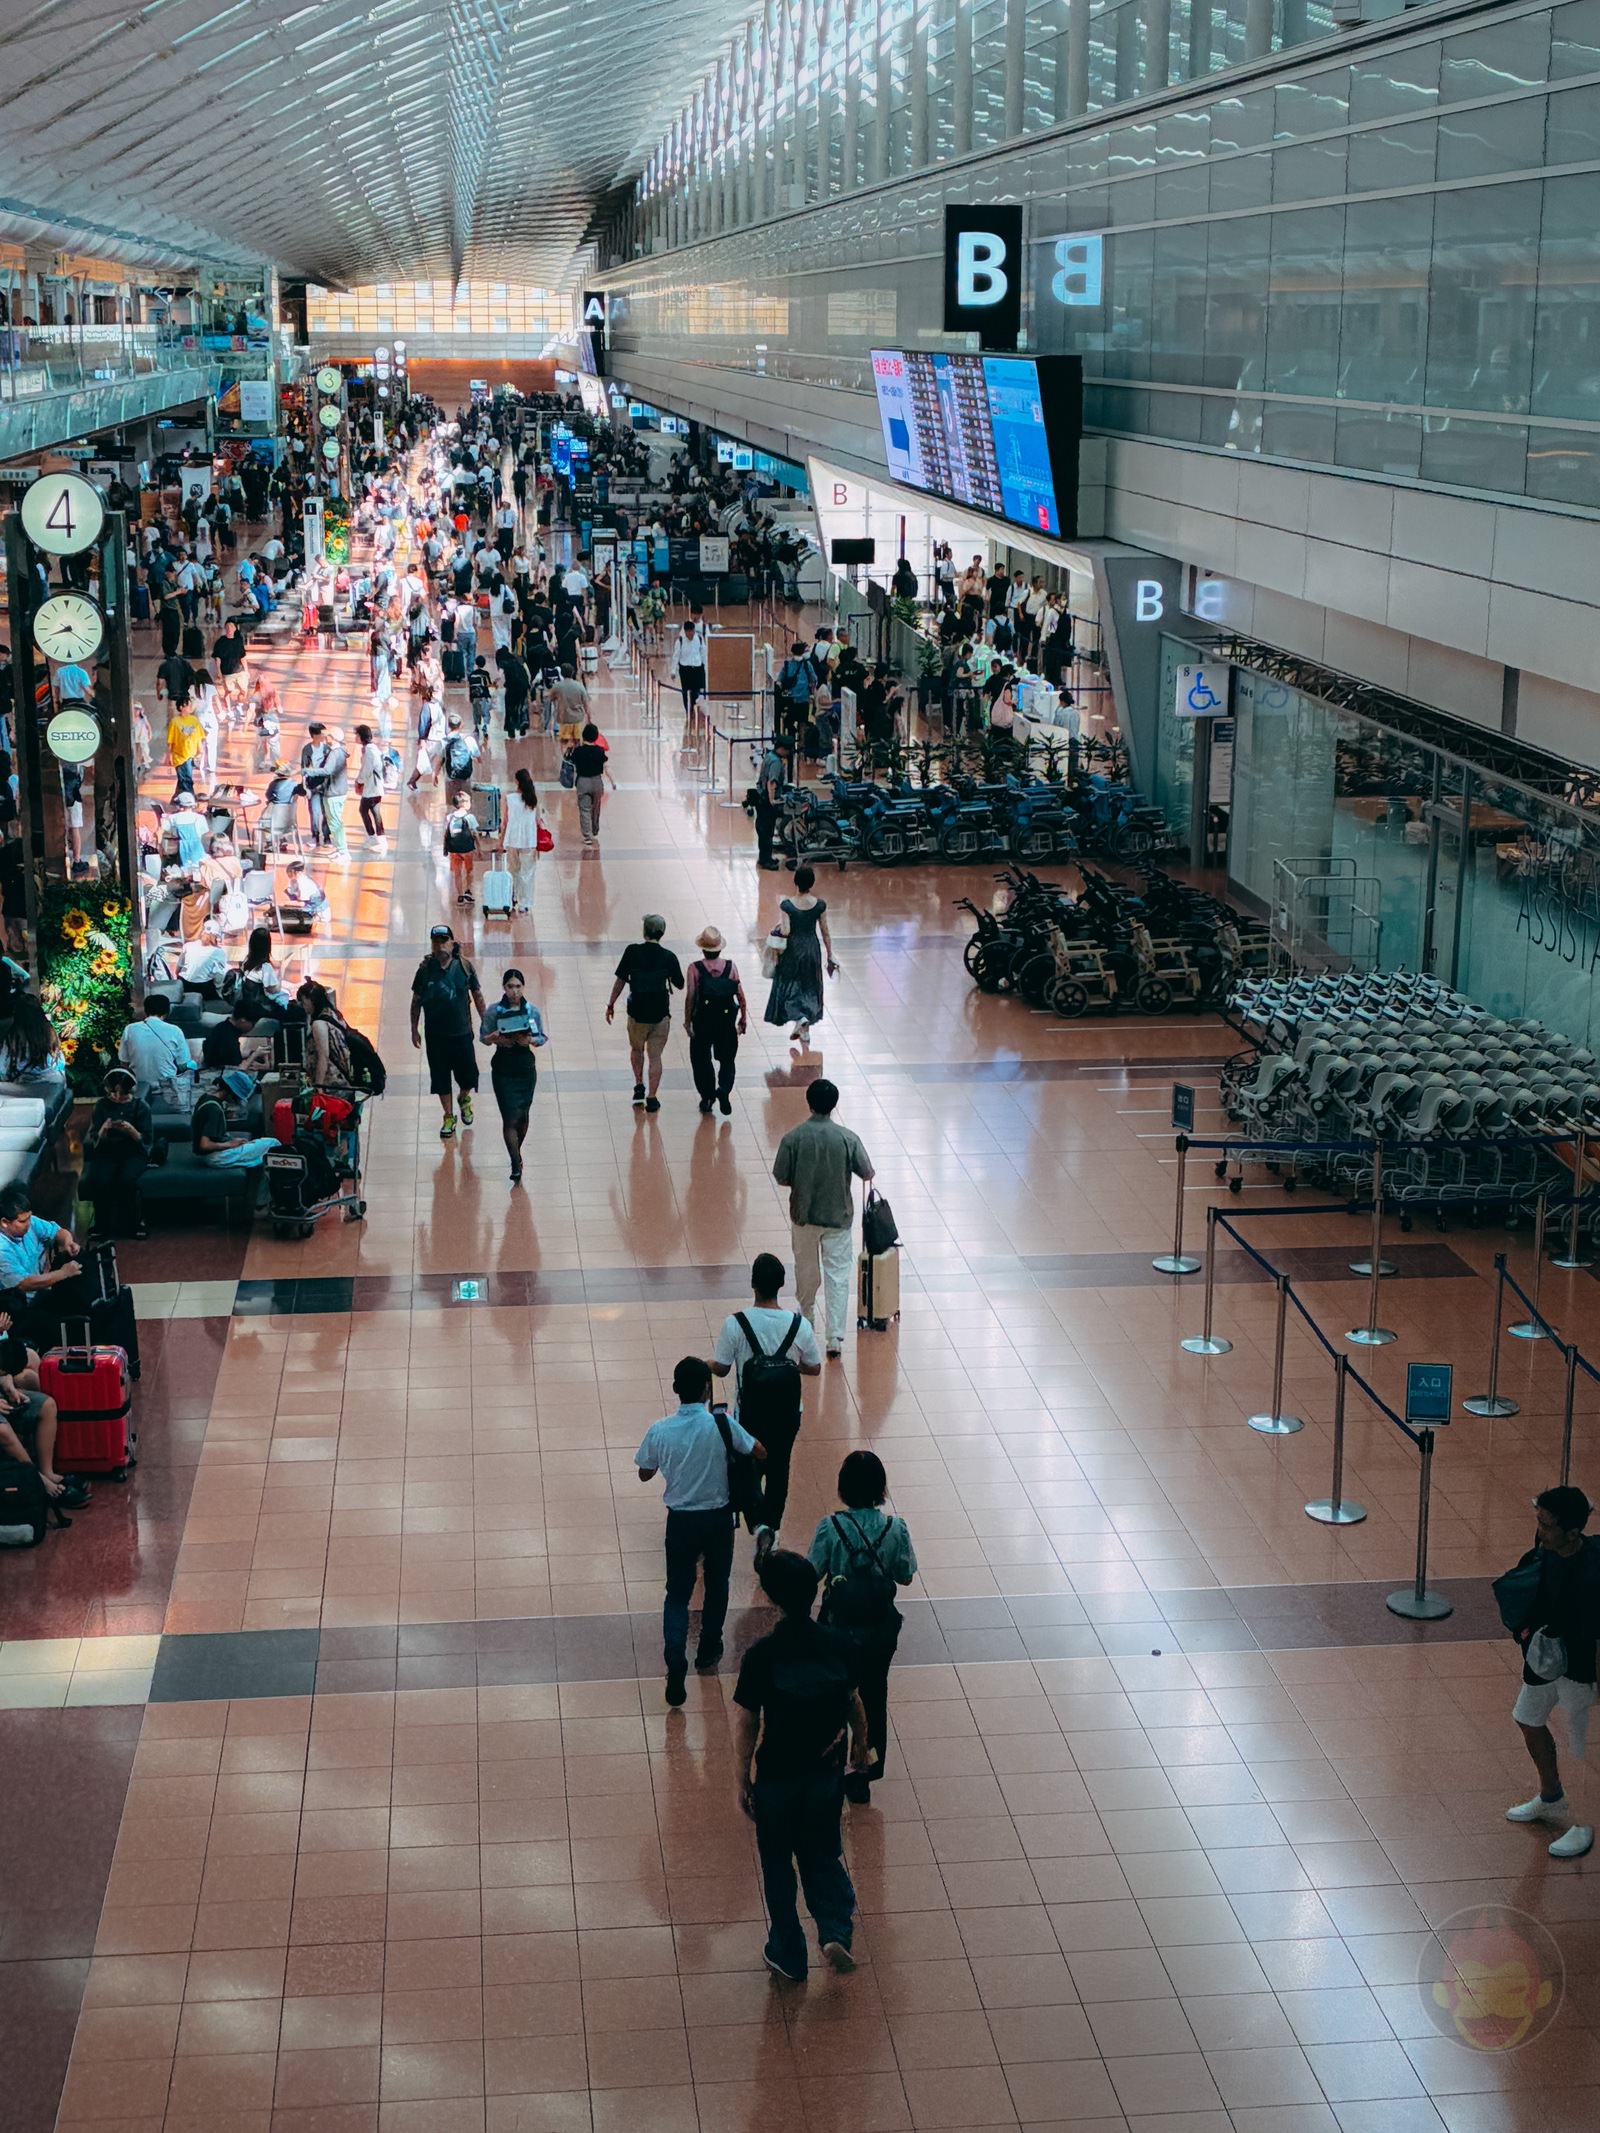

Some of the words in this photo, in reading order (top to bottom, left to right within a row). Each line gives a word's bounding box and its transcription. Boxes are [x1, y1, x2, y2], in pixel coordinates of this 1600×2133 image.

[957, 231, 1009, 306] B
[585, 297, 605, 320] A
[325, 372, 334, 389] 3
[585, 380, 594, 389] A
[608, 381, 619, 395] A
[833, 483, 848, 506] B
[45, 488, 77, 539] 4
[1135, 579, 1164, 622] B
[50, 731, 97, 742] SEIKO
[1418, 1377, 1441, 1388] 入口
